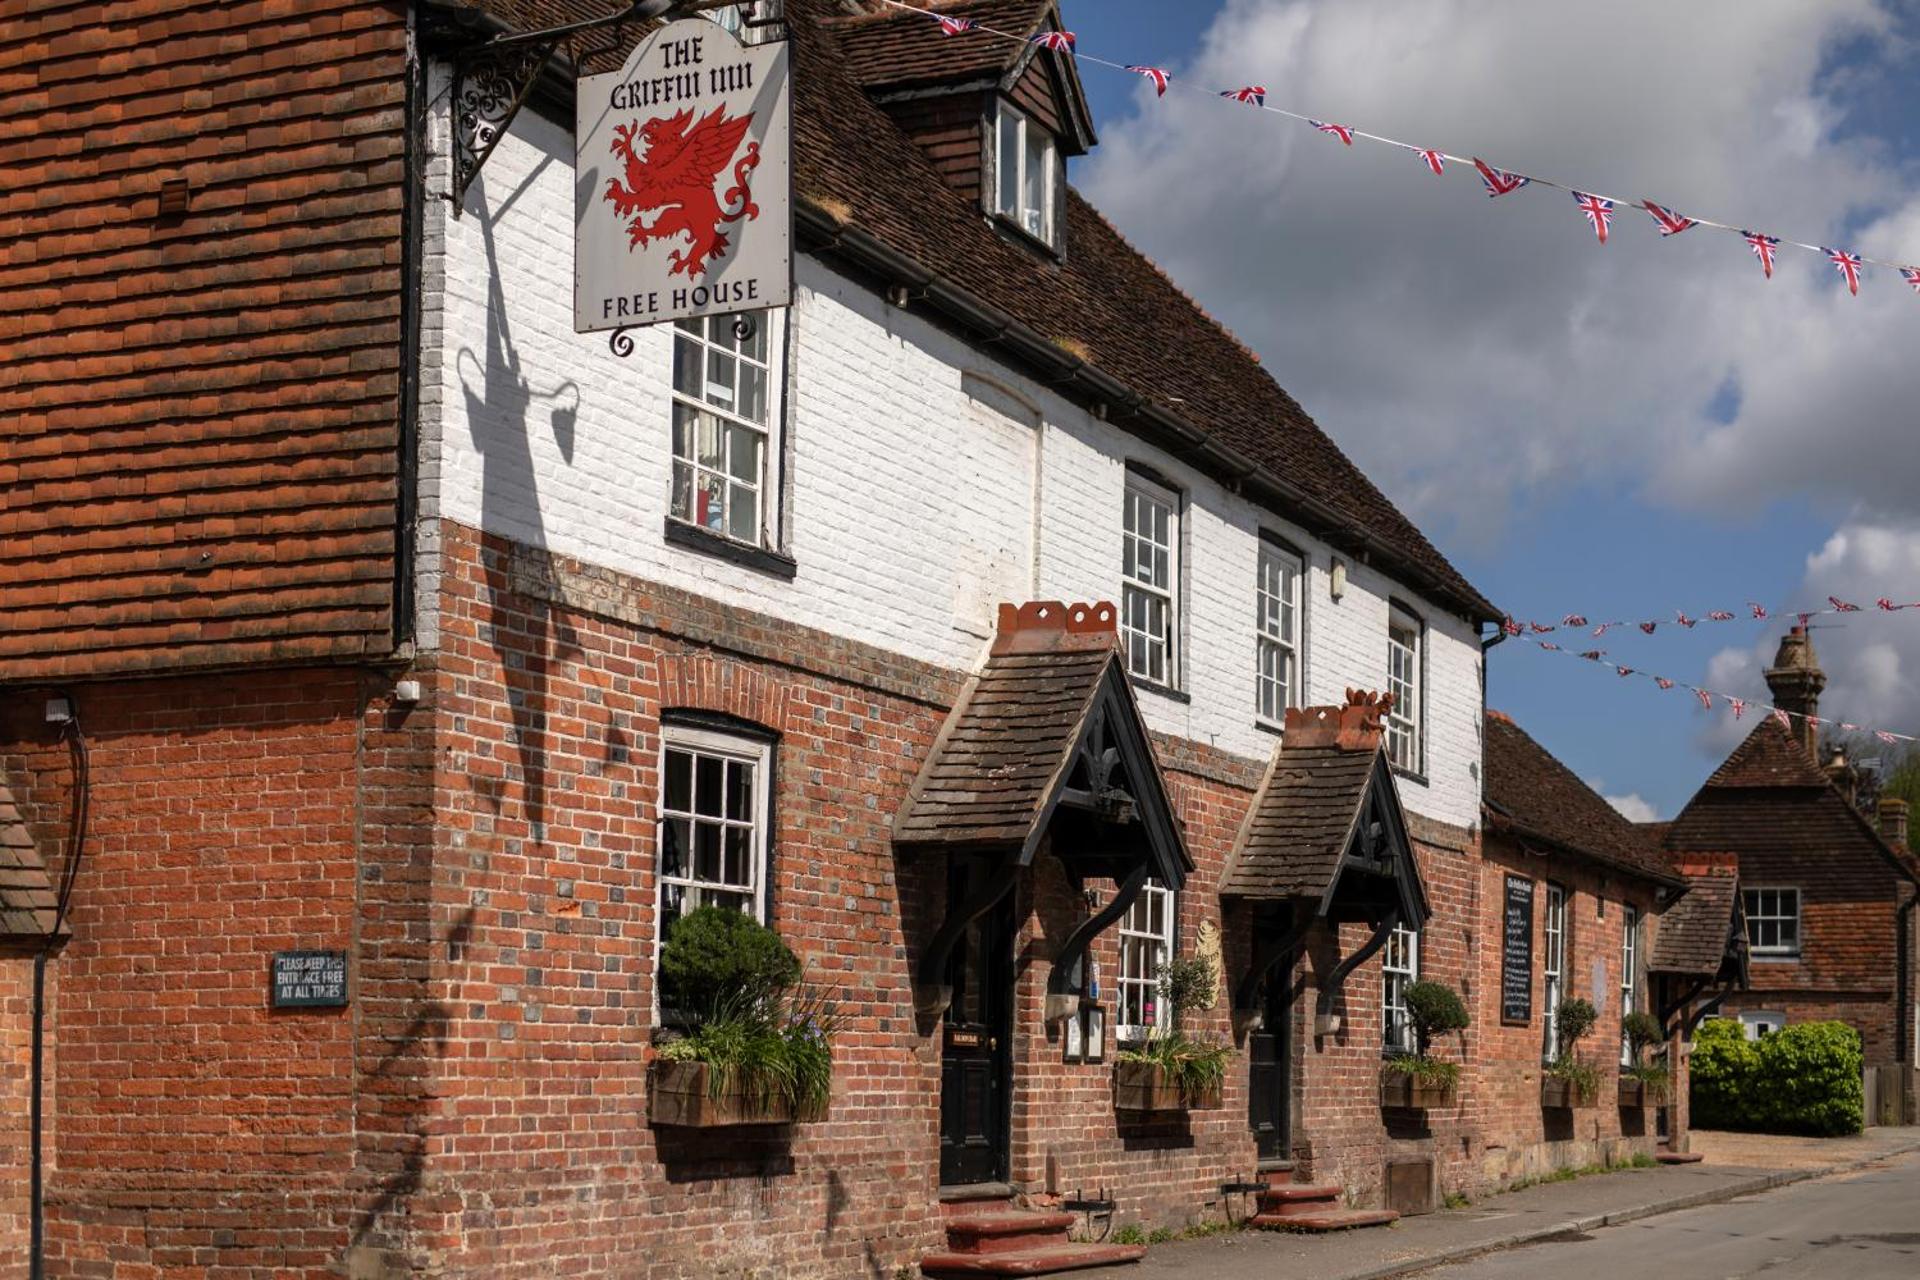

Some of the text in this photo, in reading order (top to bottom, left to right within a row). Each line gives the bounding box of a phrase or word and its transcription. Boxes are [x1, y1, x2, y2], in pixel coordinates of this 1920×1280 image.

[659, 36, 703, 69] THE
[610, 61, 752, 110] GRIFFIN INN
[603, 278, 758, 319] FREE HOUSE
[278, 957, 304, 970] PLEASE
[322, 970, 344, 983] FREE
[281, 985, 340, 998] AT ALL TIMES
